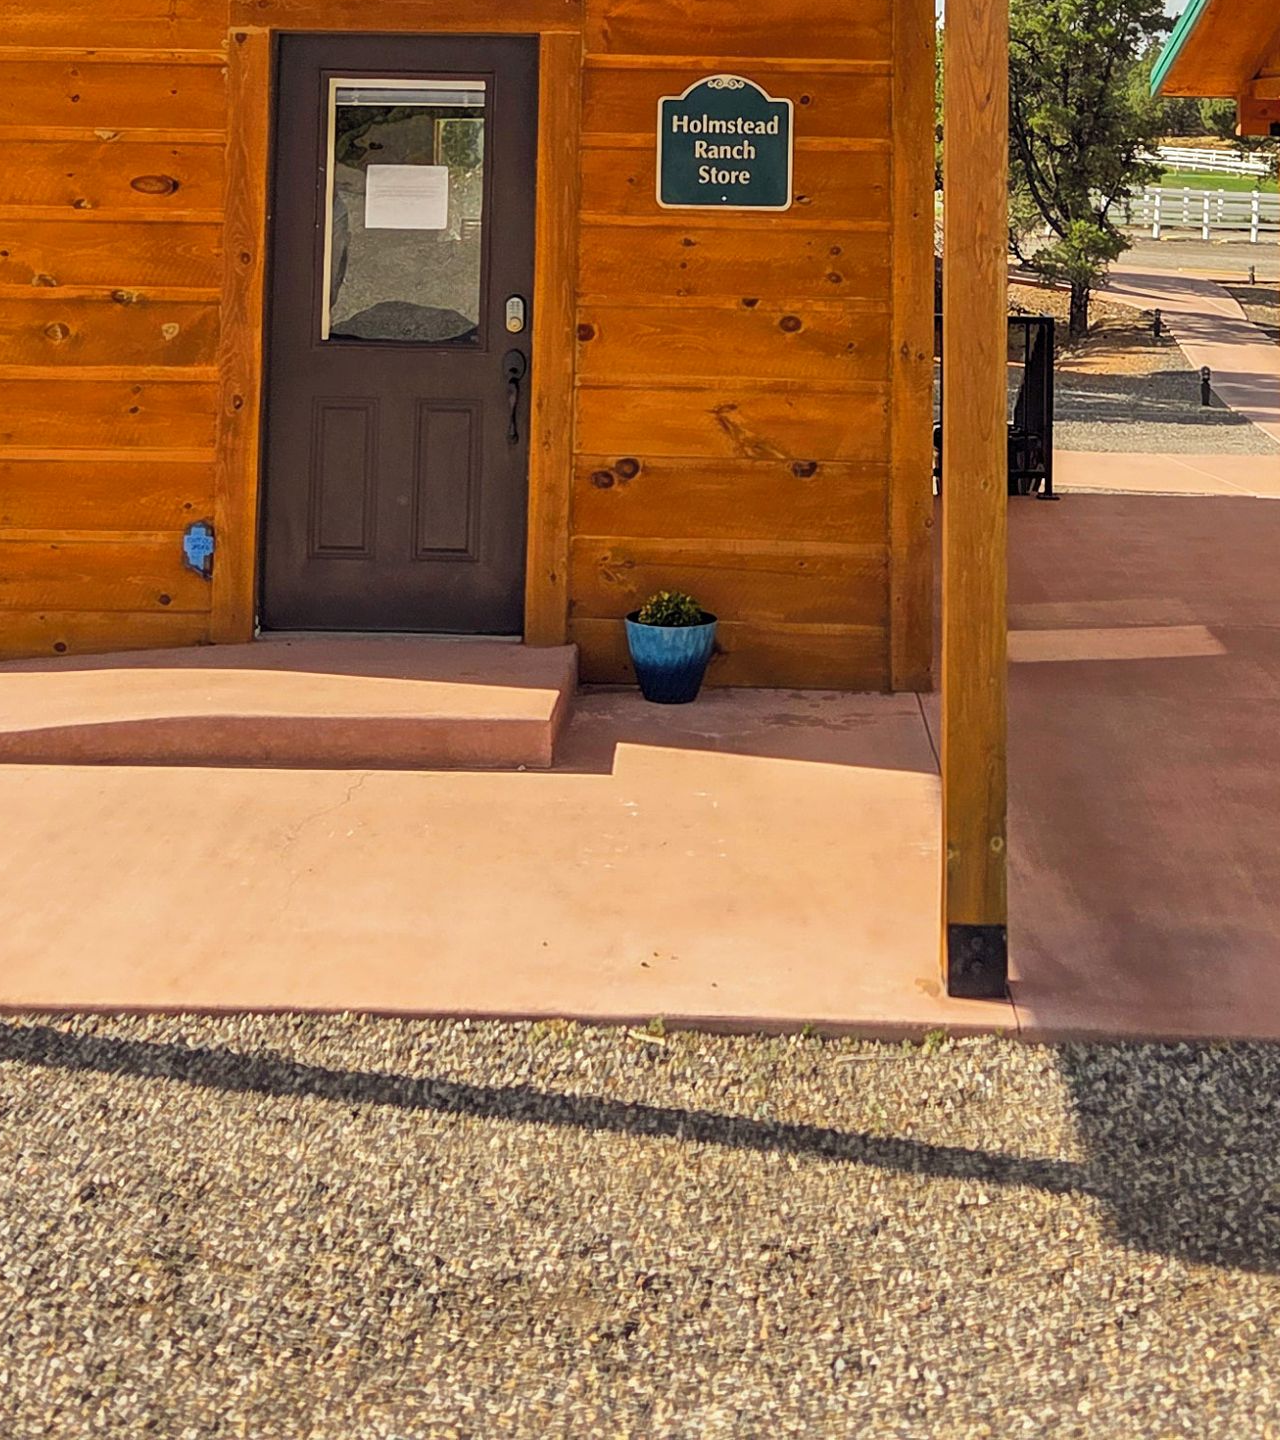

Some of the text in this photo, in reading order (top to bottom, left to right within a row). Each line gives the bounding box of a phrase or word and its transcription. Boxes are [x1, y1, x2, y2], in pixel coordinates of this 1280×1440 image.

[672, 113, 779, 134] Holmstead
[694, 140, 756, 159] Ranch
[698, 165, 751, 184] Store
